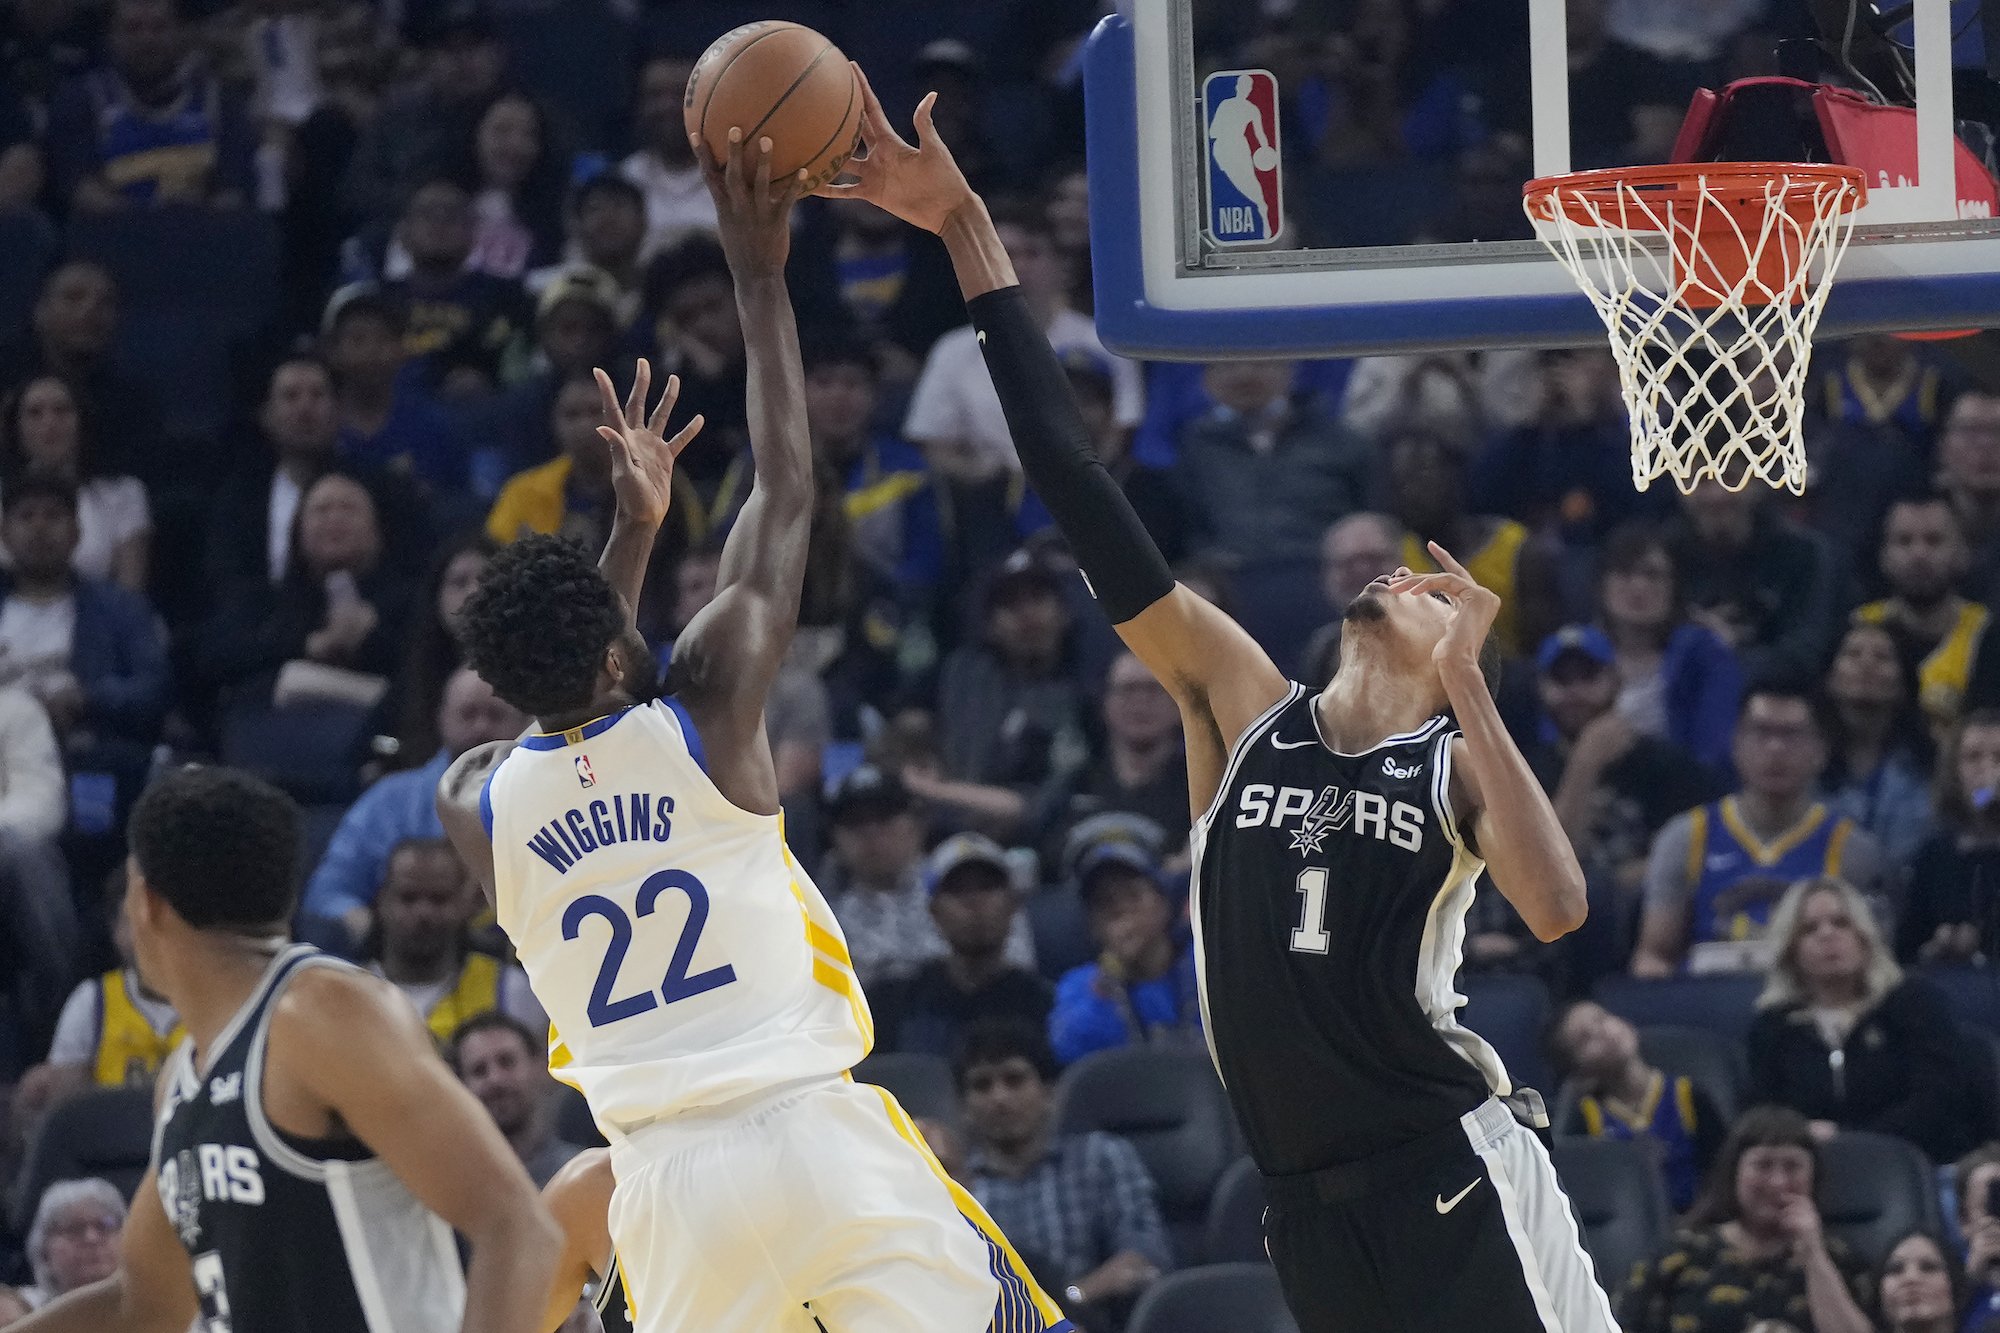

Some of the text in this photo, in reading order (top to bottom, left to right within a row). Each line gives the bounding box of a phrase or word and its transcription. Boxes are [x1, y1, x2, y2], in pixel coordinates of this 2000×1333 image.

[1219, 206, 1255, 234] NBA
[1381, 756, 1423, 779] Self
[526, 793, 676, 875] WIGGINS
[1235, 784, 1426, 855] SPURS
[561, 868, 738, 1028] 22
[1289, 866, 1331, 955] 1
